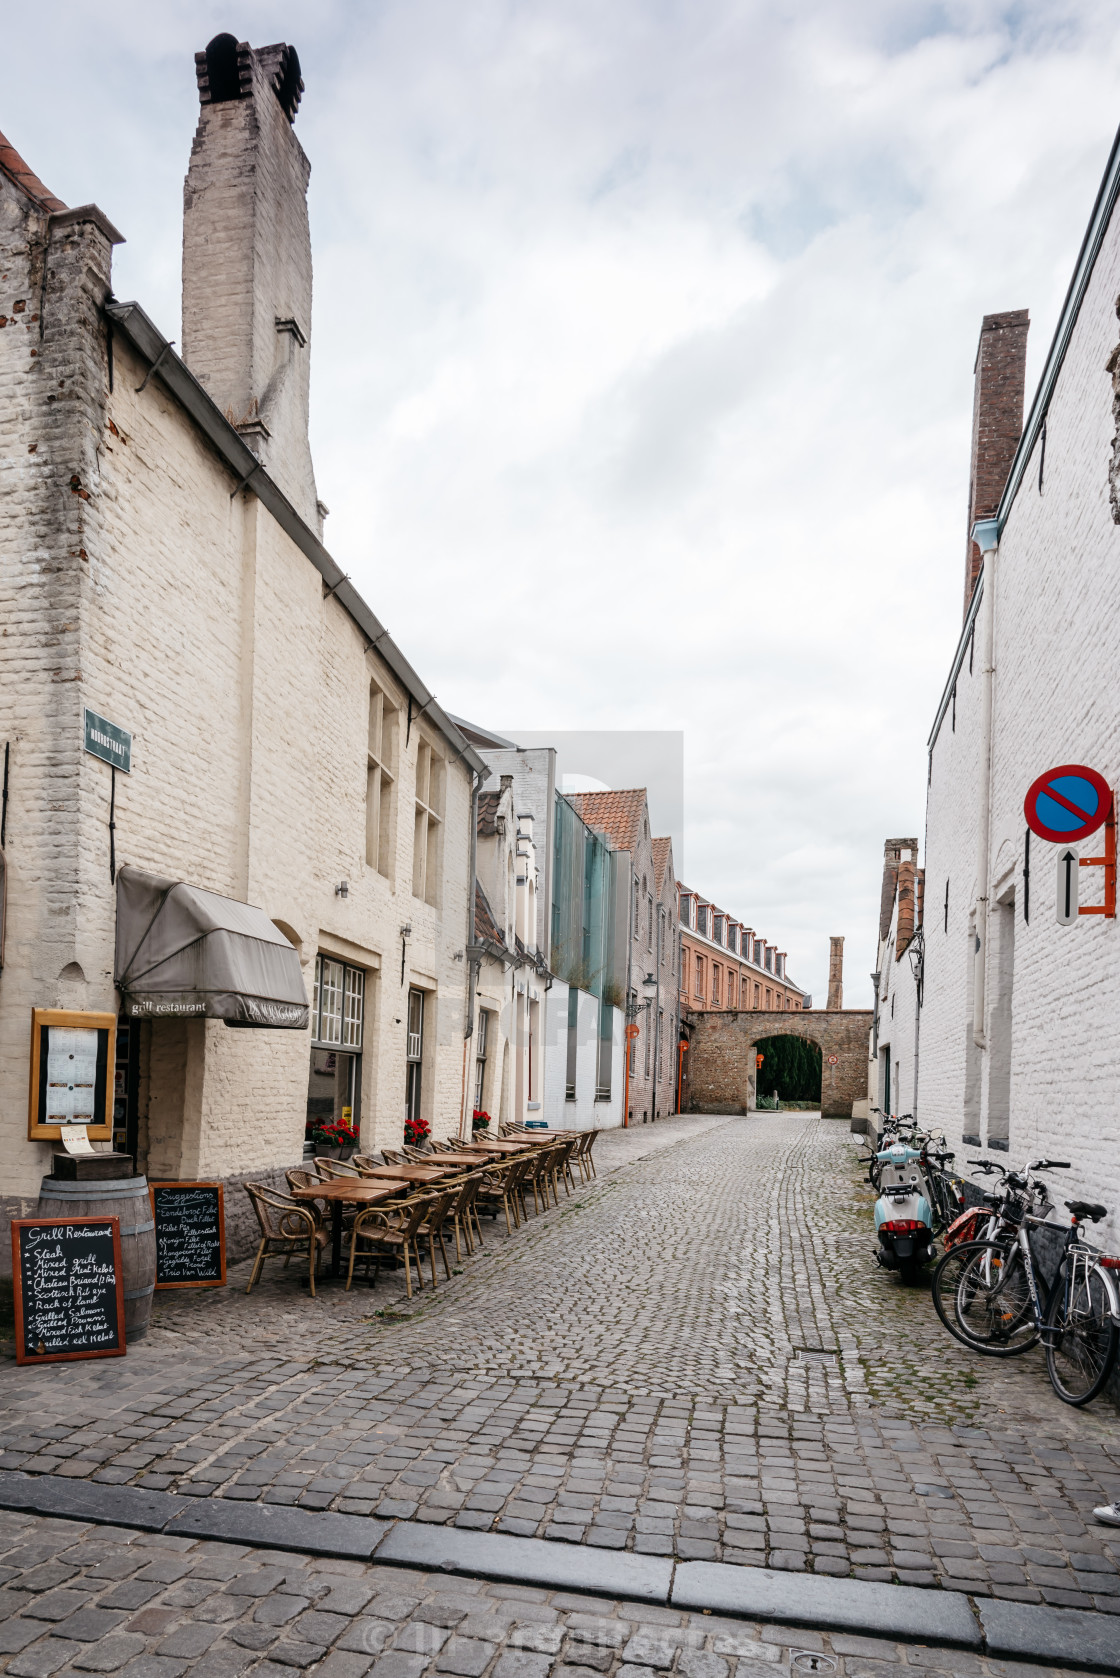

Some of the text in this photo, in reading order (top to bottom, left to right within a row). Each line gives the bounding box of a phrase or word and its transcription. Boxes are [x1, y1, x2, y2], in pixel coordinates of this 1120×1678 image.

[131, 1001, 206, 1015] grill restaurant
[161, 1189, 214, 1205] Suggestions
[26, 1226, 112, 1249] Grill Restaurant
[34, 1245, 63, 1261] Steak
[34, 1254, 96, 1269] Mixed grill
[34, 1268, 66, 1278] Mixed
[35, 1300, 60, 1310] Rack
[35, 1312, 64, 1323] Grilled
[39, 1326, 66, 1337] Mixed
[68, 1325, 83, 1334] Fish
